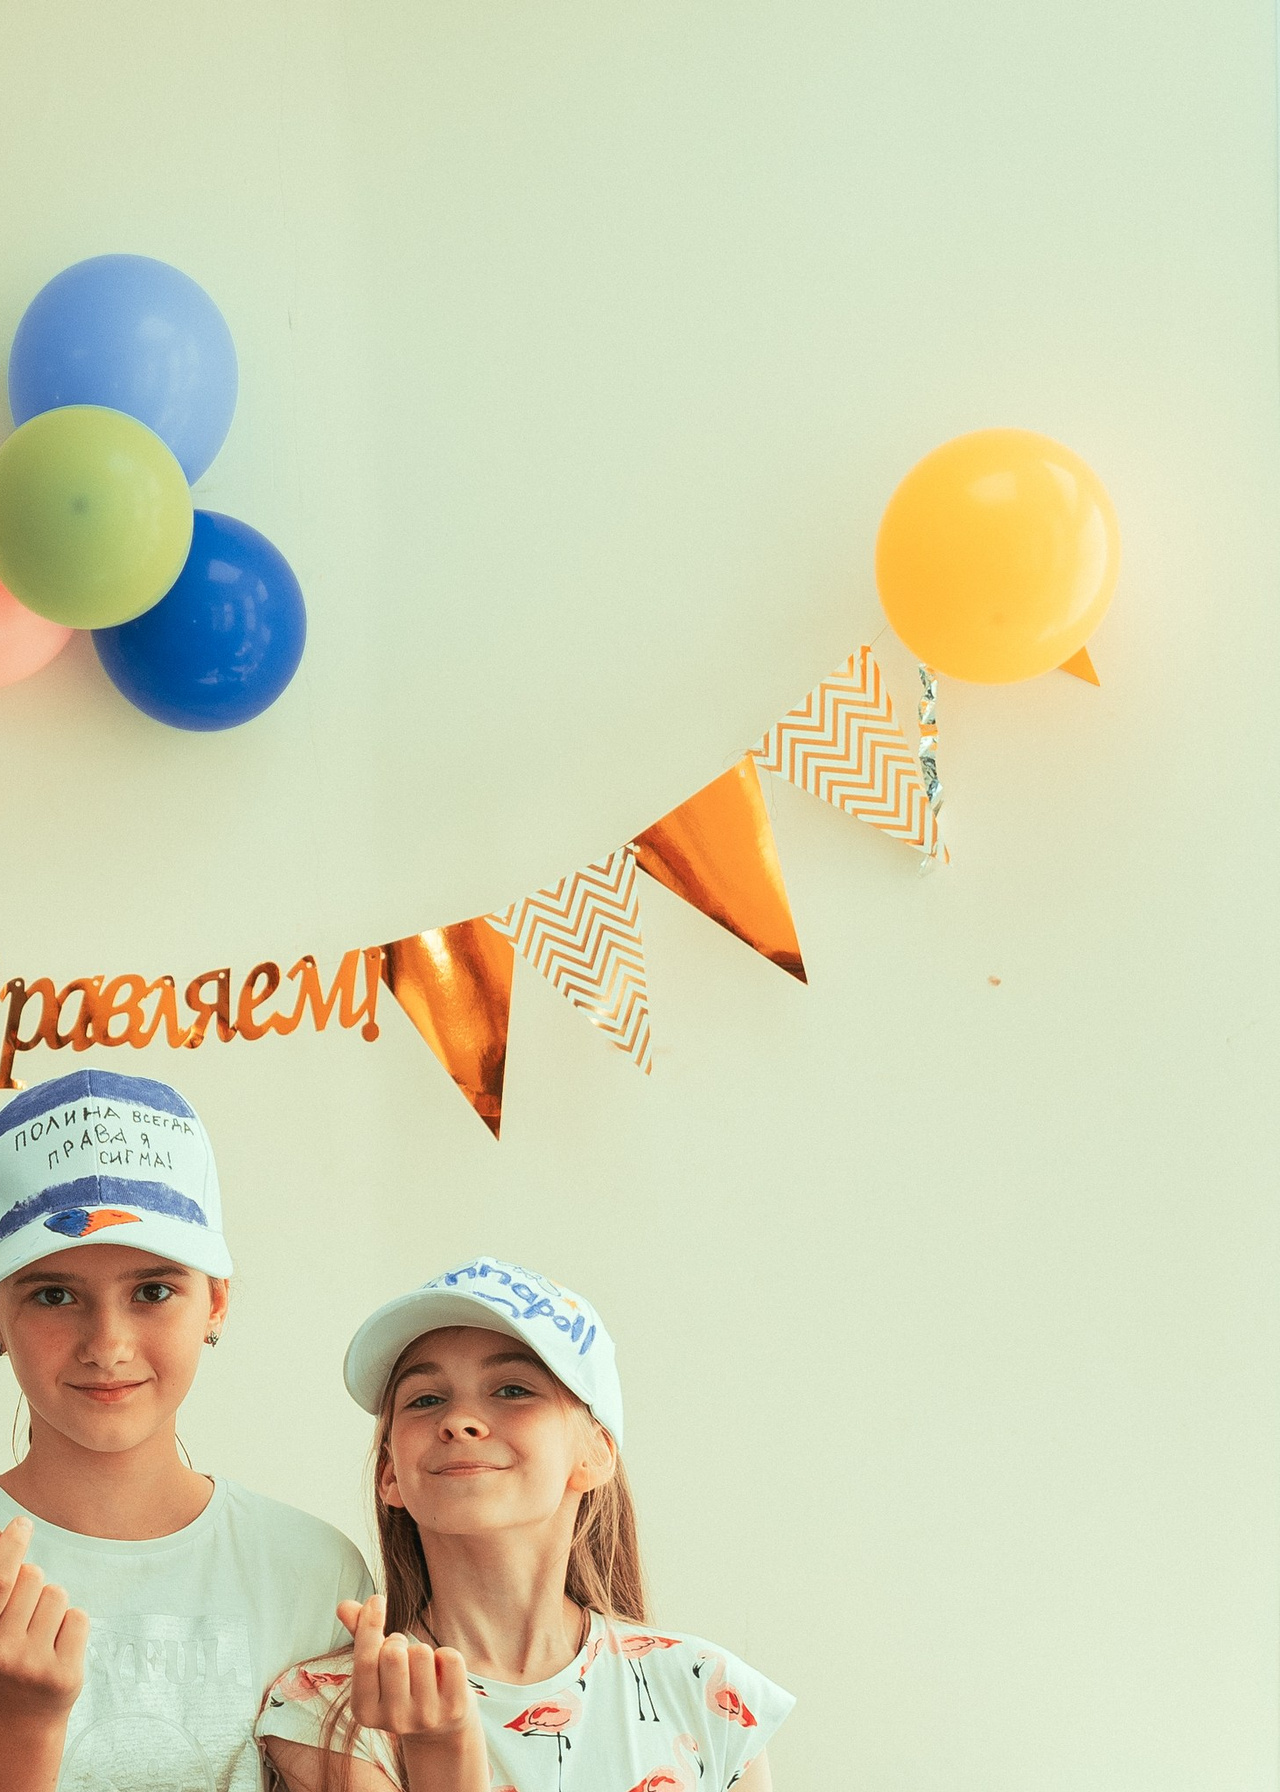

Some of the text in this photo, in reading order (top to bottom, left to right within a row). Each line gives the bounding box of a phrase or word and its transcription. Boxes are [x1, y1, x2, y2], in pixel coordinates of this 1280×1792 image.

[14, 1105, 195, 1152] ПОЛИНА ВСЕГДА
[47, 1123, 151, 1170] ПРАВА Я
[99, 1149, 173, 1170] СИГМА!
